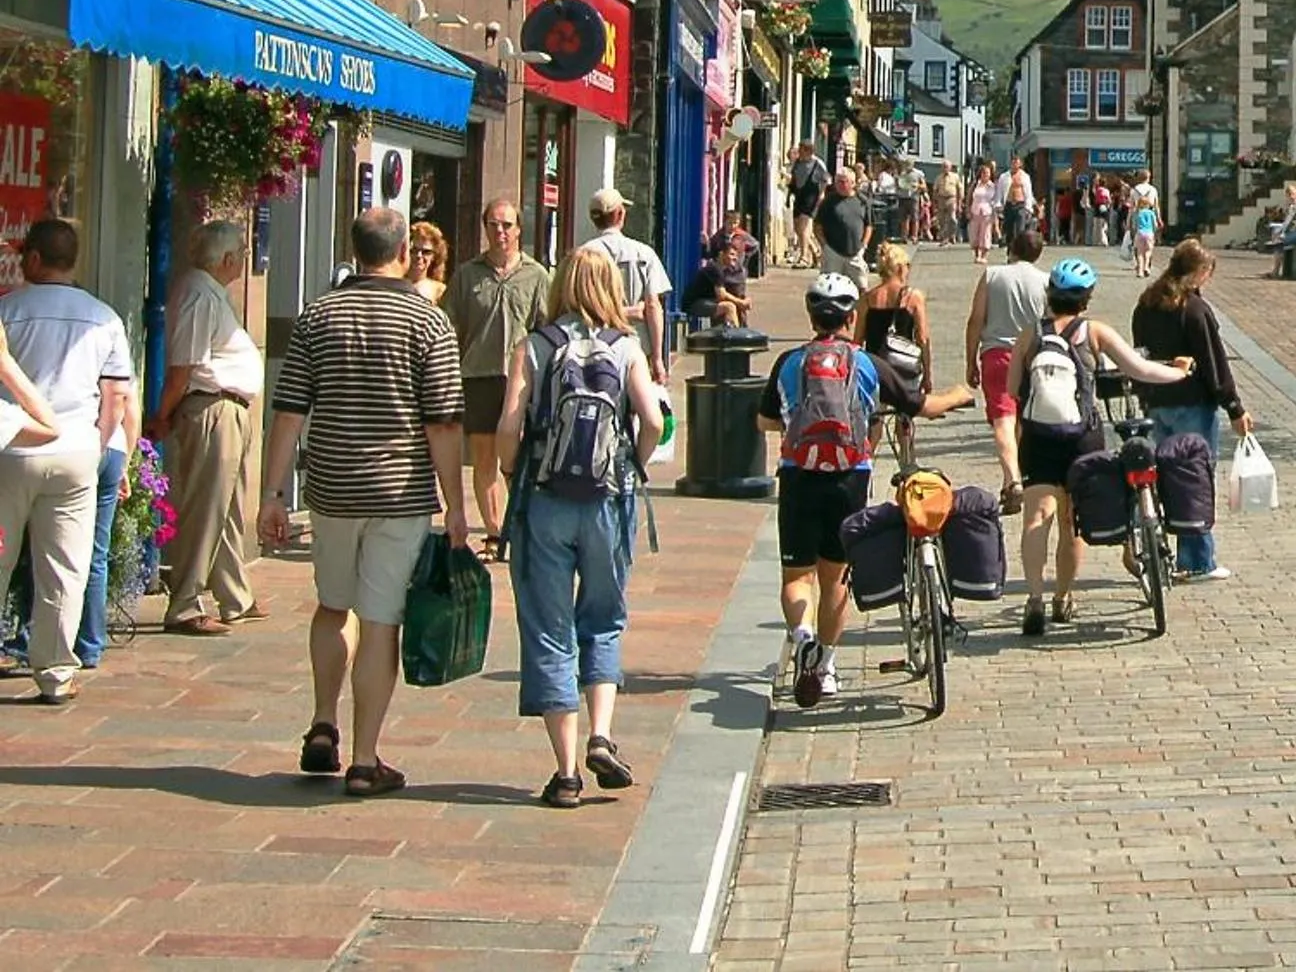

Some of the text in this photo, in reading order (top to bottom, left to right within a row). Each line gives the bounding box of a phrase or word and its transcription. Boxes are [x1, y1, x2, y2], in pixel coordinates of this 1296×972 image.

[340, 53, 376, 96] SHOES
[0, 124, 44, 188] ALE
[1107, 151, 1146, 163] GREGGS
